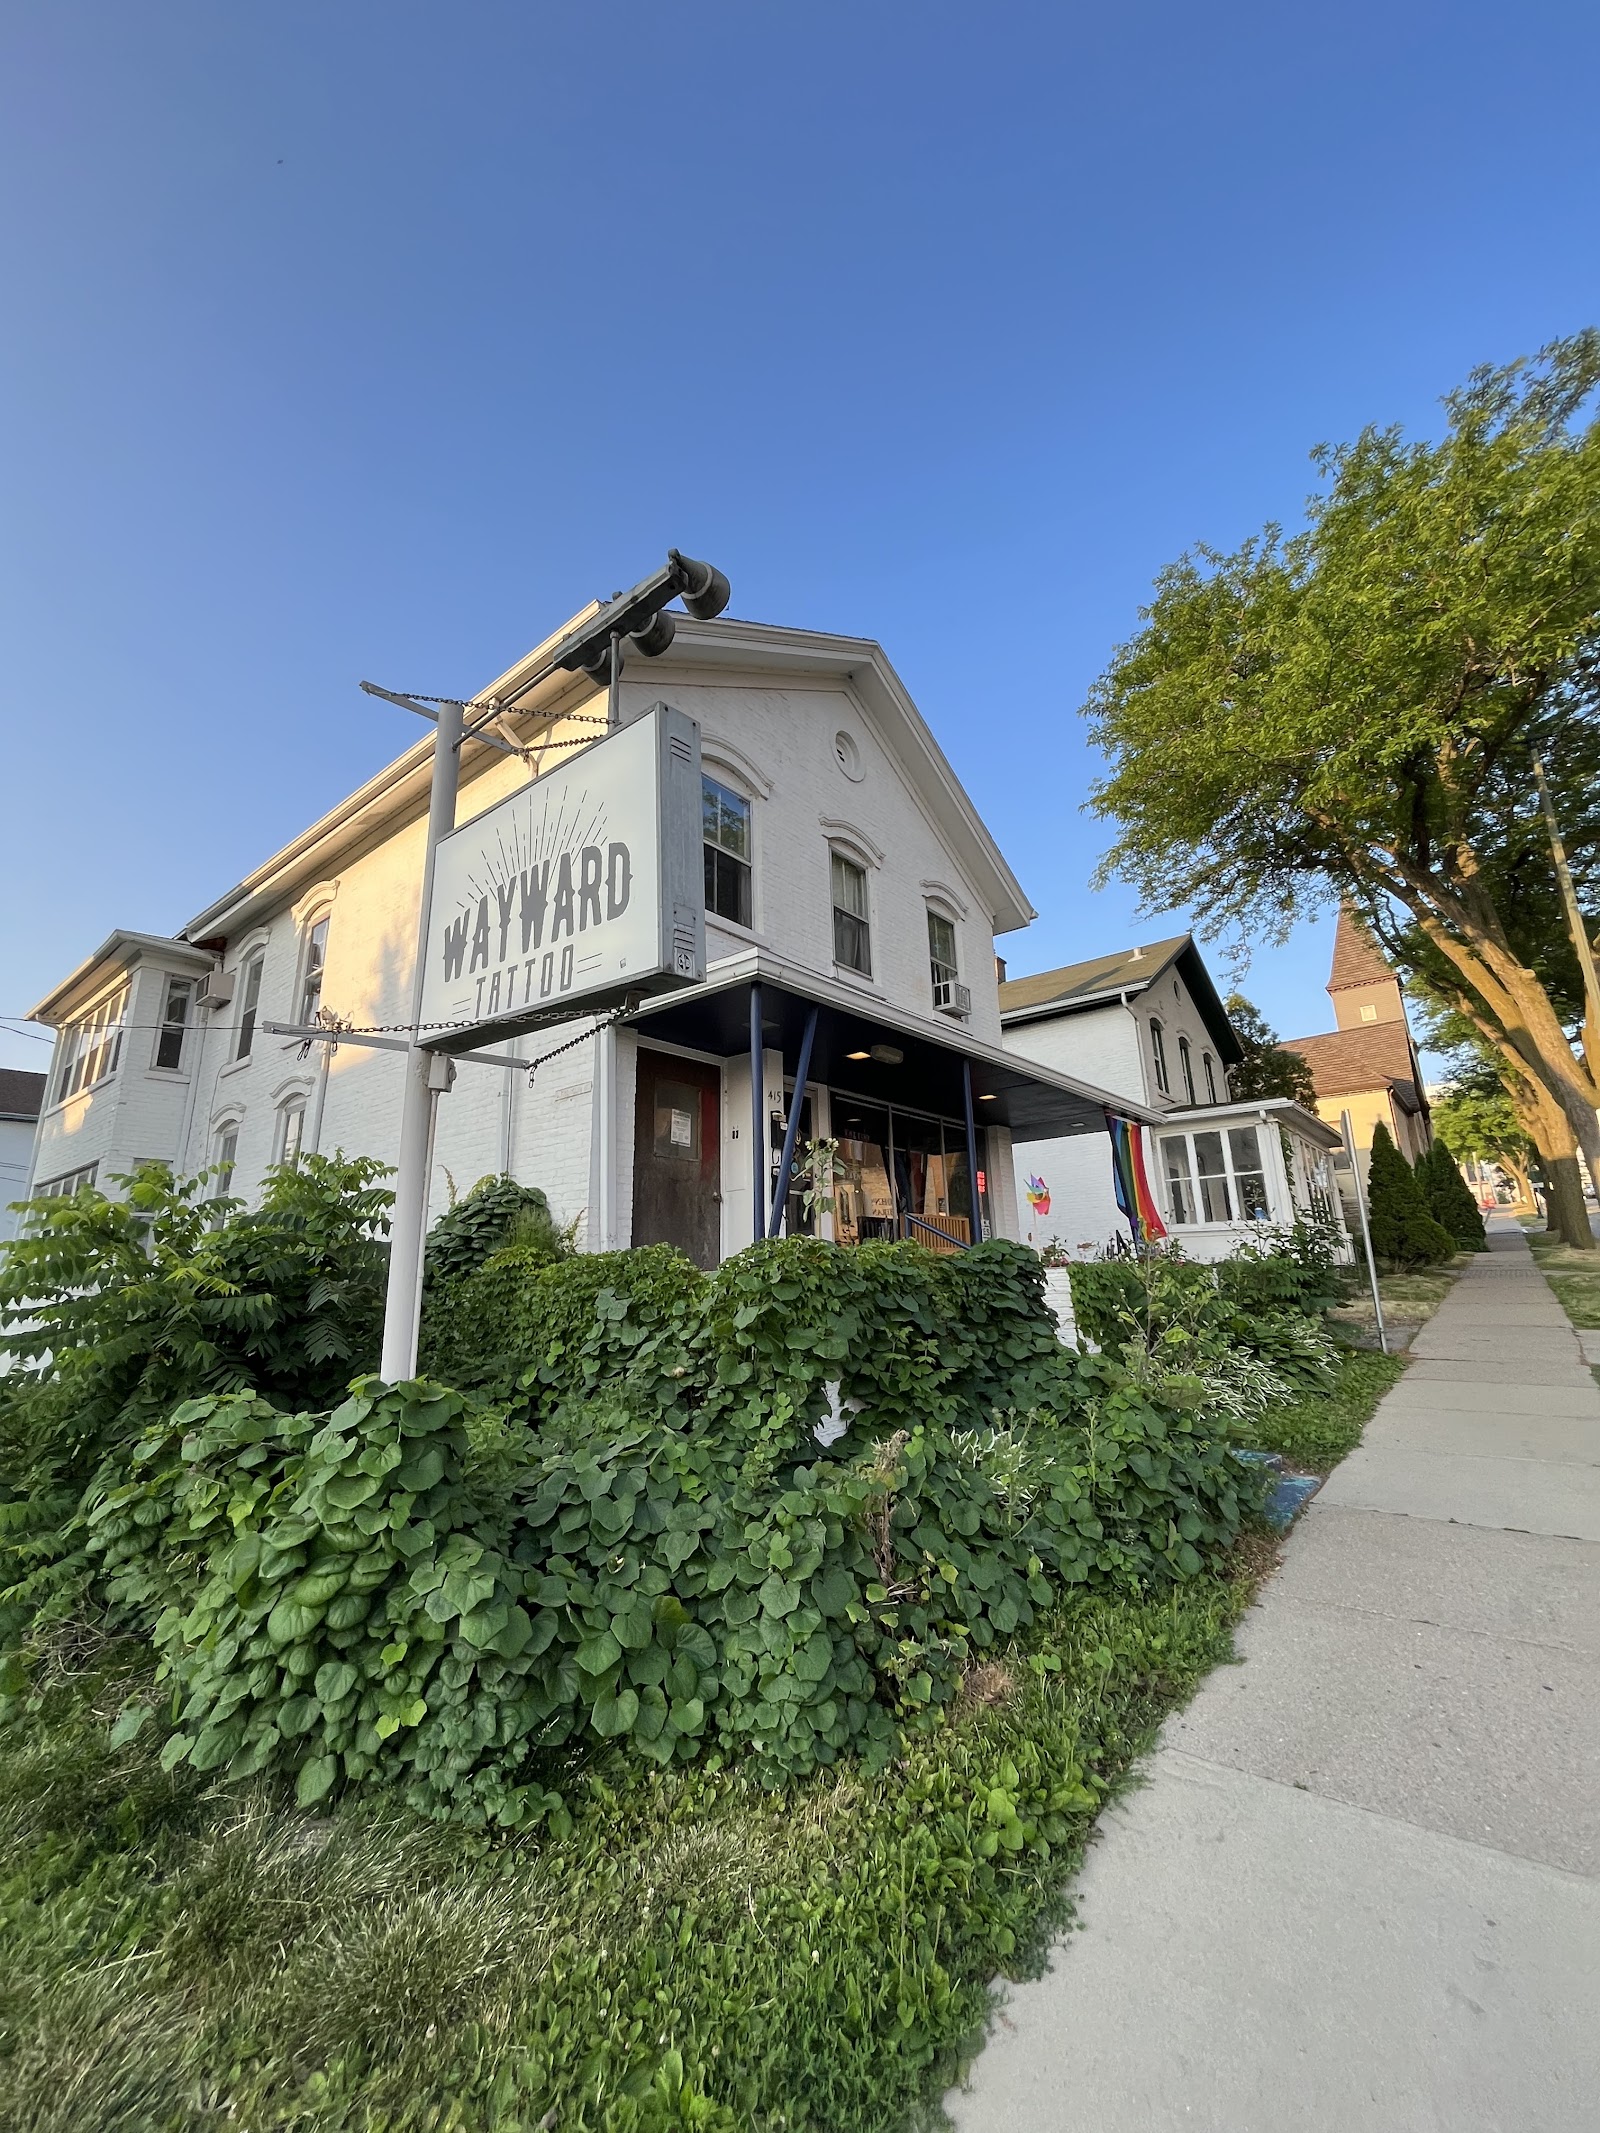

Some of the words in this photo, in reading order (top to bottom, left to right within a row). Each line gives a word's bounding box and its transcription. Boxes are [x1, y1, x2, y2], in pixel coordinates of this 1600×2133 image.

[443, 842, 633, 982] WAYWARD
[475, 944, 574, 1019] TATTOO
[768, 1090, 782, 1104] 415
